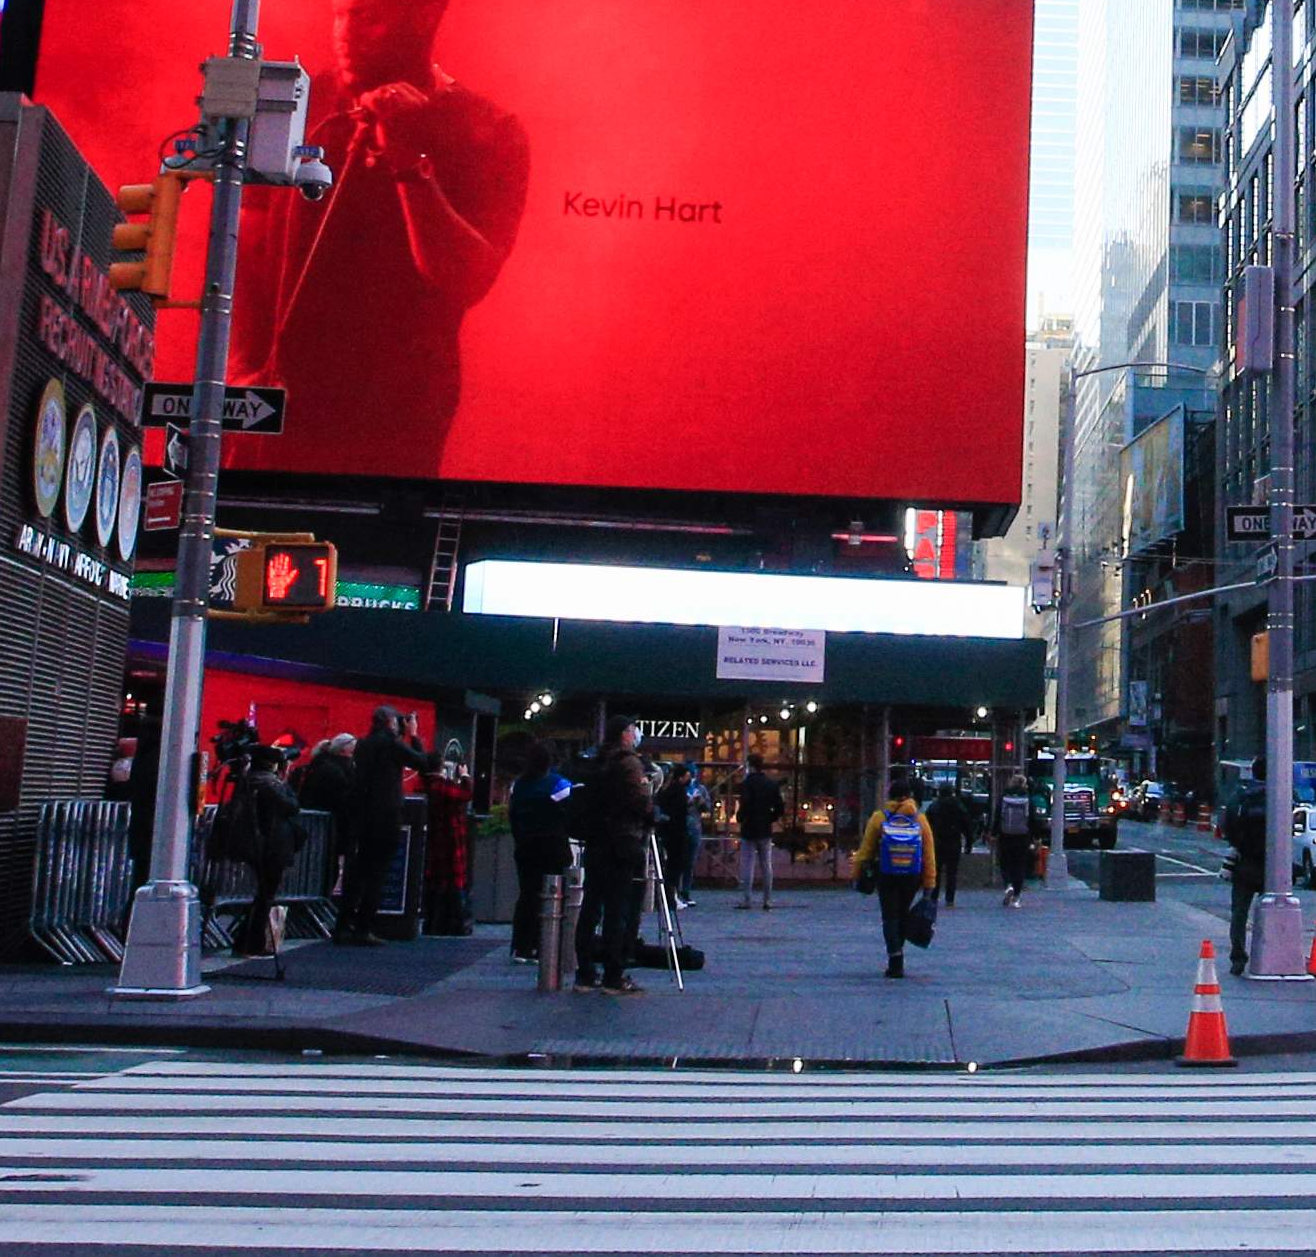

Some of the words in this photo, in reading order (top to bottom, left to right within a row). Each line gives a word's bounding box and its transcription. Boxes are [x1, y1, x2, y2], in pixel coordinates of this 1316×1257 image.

[564, 191, 644, 220] Kevin
[655, 197, 723, 224] Hart
[163, 397, 190, 414] ON
[636, 720, 700, 738] TIZEN
